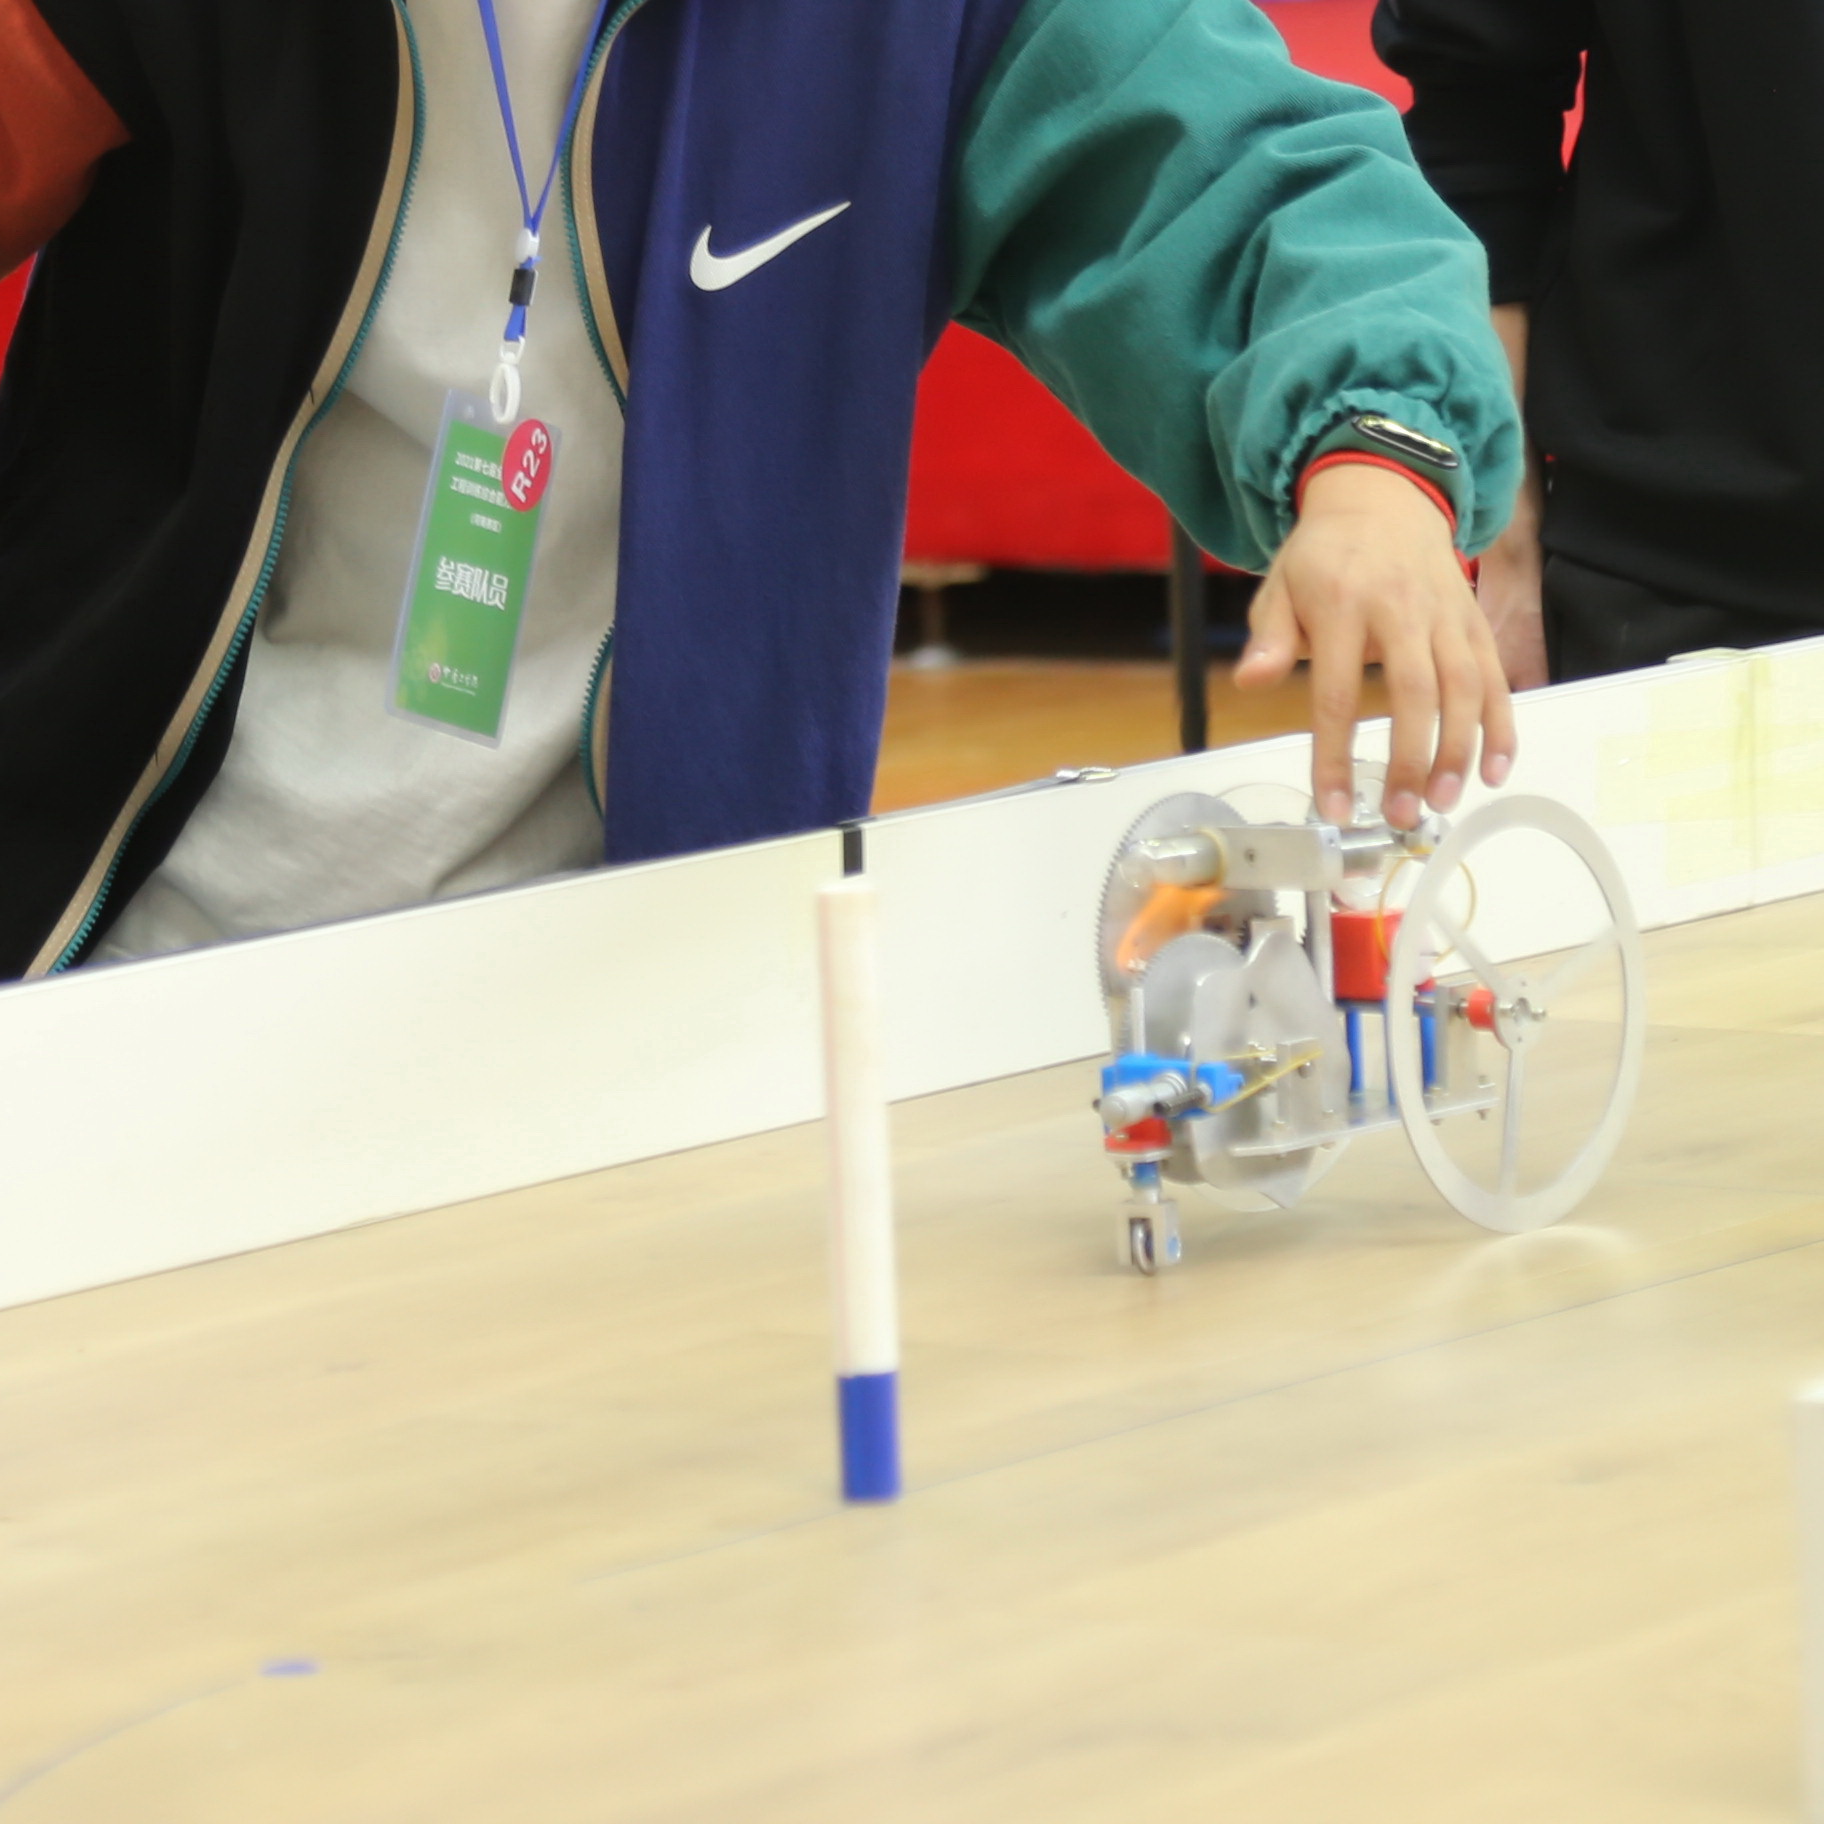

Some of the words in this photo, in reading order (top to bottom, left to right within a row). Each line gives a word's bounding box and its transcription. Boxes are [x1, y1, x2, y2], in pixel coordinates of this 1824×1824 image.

[510, 427, 548, 504] R23
[434, 556, 509, 611] 参赛队员
